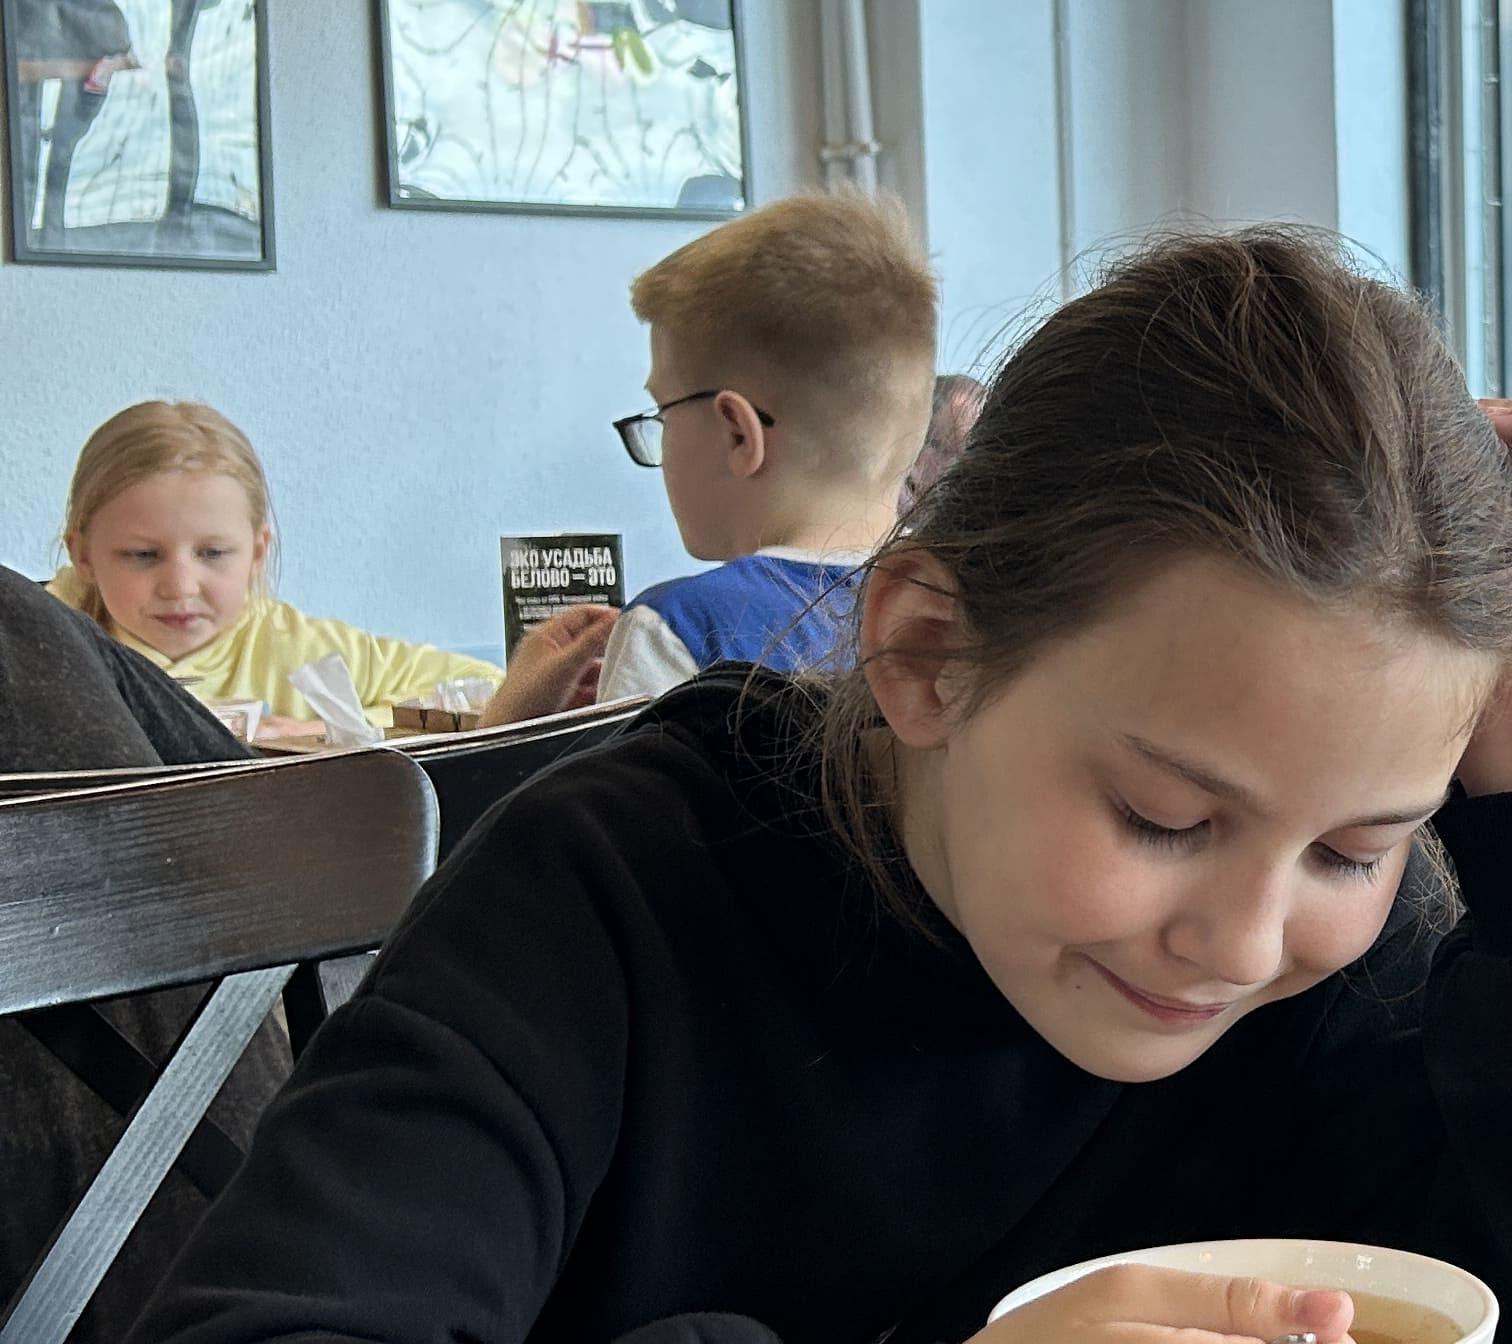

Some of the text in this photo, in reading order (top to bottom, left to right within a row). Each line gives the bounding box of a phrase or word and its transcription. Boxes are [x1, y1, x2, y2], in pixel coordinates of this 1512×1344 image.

[510, 546, 613, 569] ЭКО УСАДЬБА
[511, 567, 570, 589] БЕЛОВО
[588, 566, 616, 587] ЭТО
